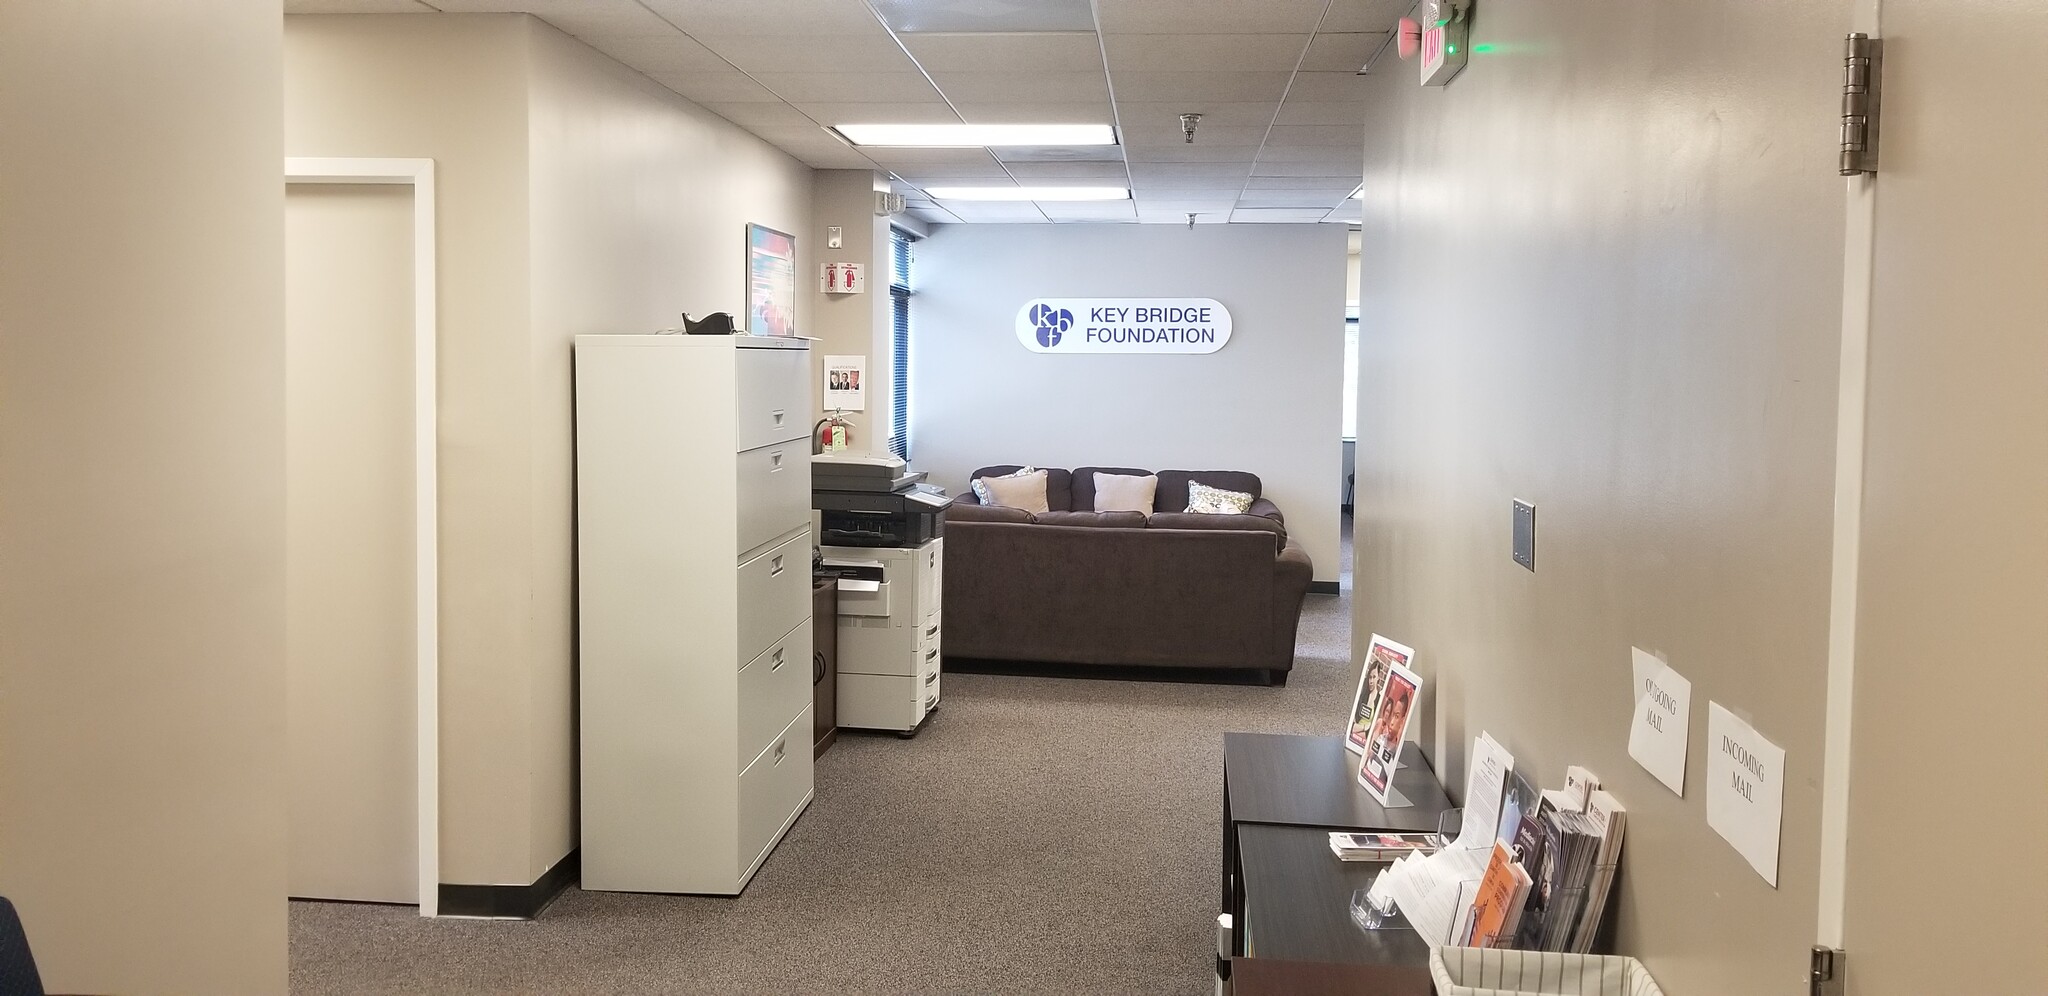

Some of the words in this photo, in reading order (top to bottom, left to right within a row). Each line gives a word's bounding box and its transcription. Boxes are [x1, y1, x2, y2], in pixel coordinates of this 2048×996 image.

[1091, 307, 1129, 323] KEY
[1136, 307, 1211, 323] BRIDGE
[1086, 328, 1215, 343] FOUNDATION
[1645, 678, 1677, 716] OUTGOING
[1646, 708, 1663, 734] MAIL
[1722, 734, 1766, 783] INCOMING
[1731, 771, 1754, 803] MAIL
